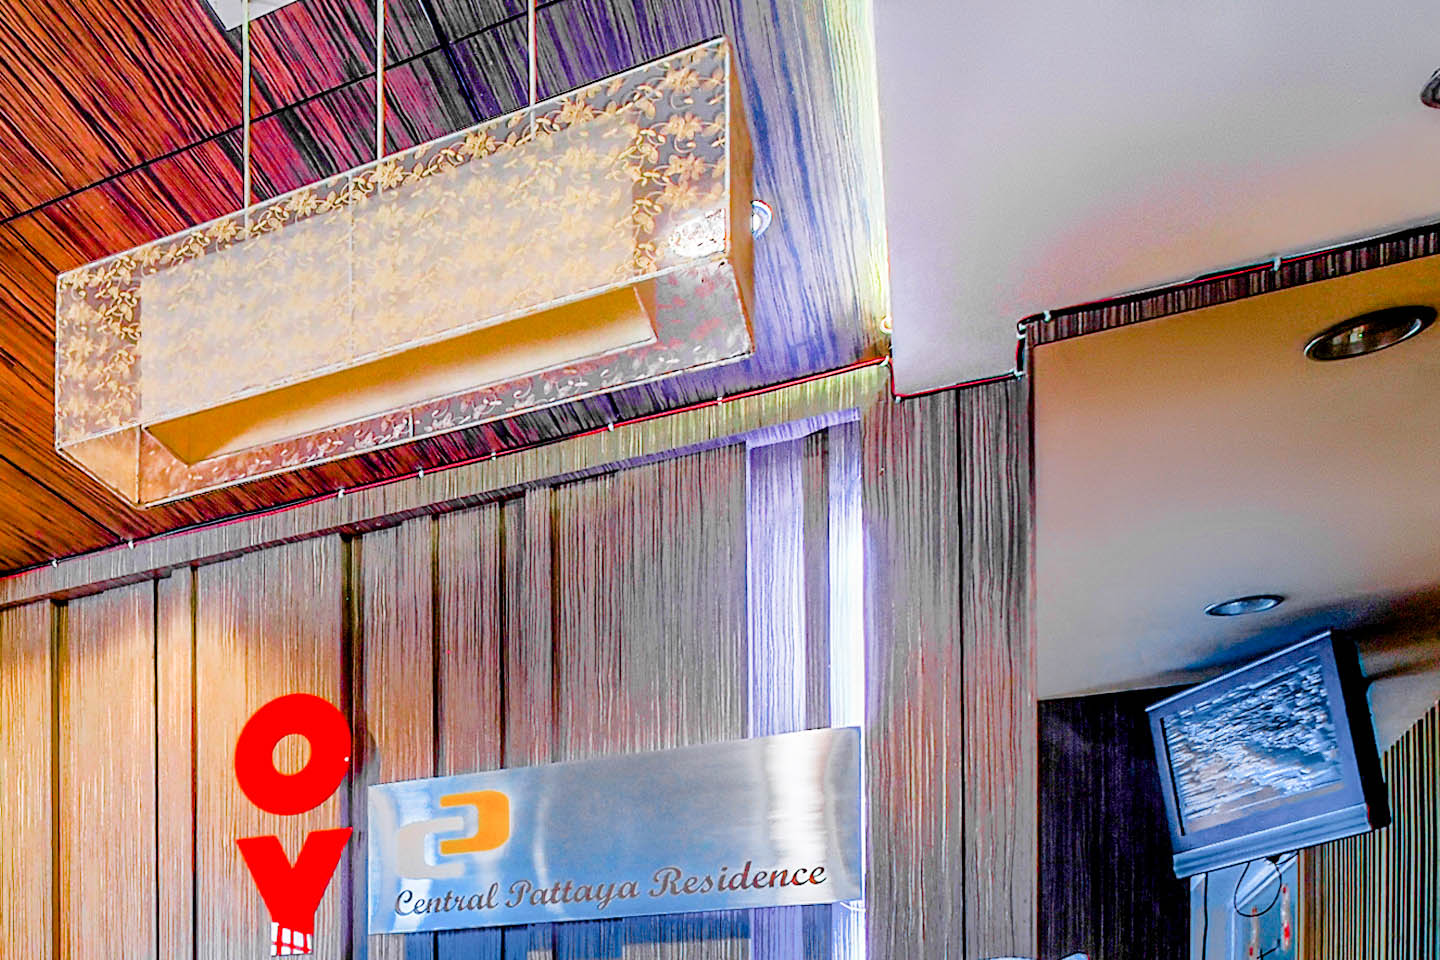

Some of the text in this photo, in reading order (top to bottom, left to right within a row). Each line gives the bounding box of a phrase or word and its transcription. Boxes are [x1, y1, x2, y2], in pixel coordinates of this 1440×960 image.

[394, 859, 829, 917] Central Pattaya Residence
